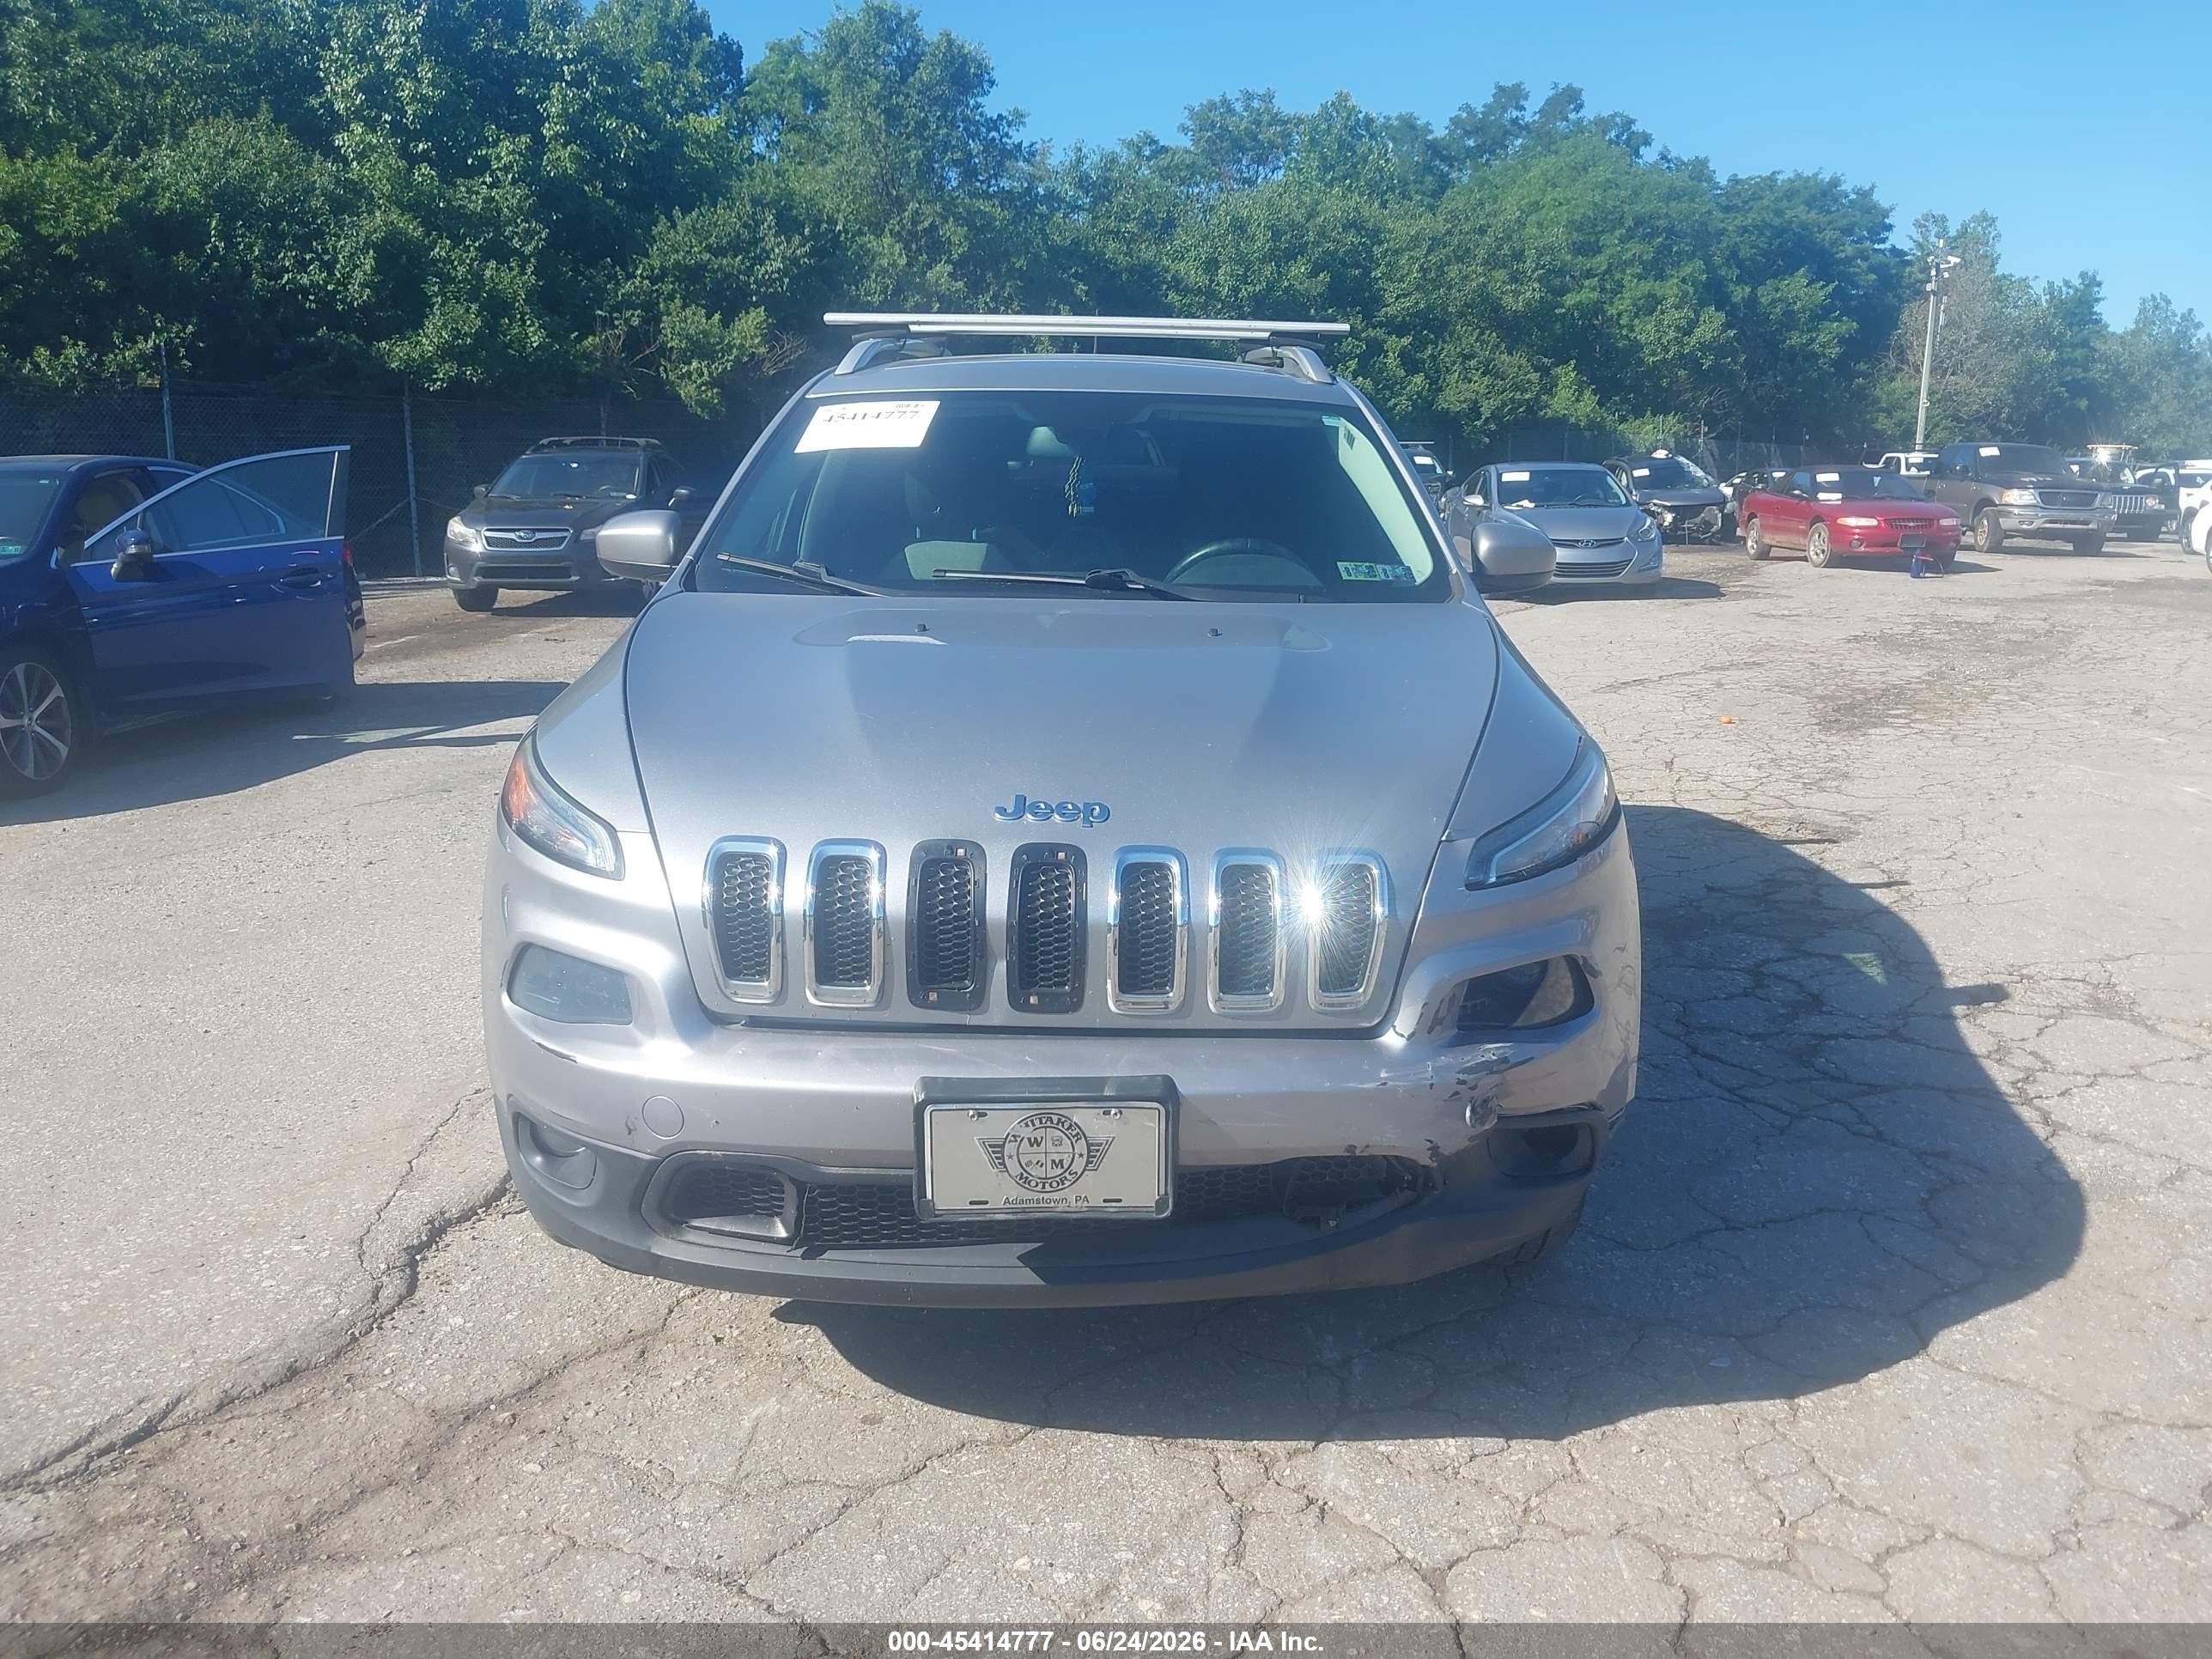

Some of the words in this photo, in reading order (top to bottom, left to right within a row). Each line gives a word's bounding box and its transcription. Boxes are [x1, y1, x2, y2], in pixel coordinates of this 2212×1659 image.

[994, 794, 1111, 828] Jeep
[1026, 1136, 1043, 1148] W
[1050, 1158, 1065, 1170] M
[1015, 1169, 1079, 1190] MOTORS
[1002, 1195, 1071, 1207] Adamstown,
[1074, 1194, 1091, 1205] PA
